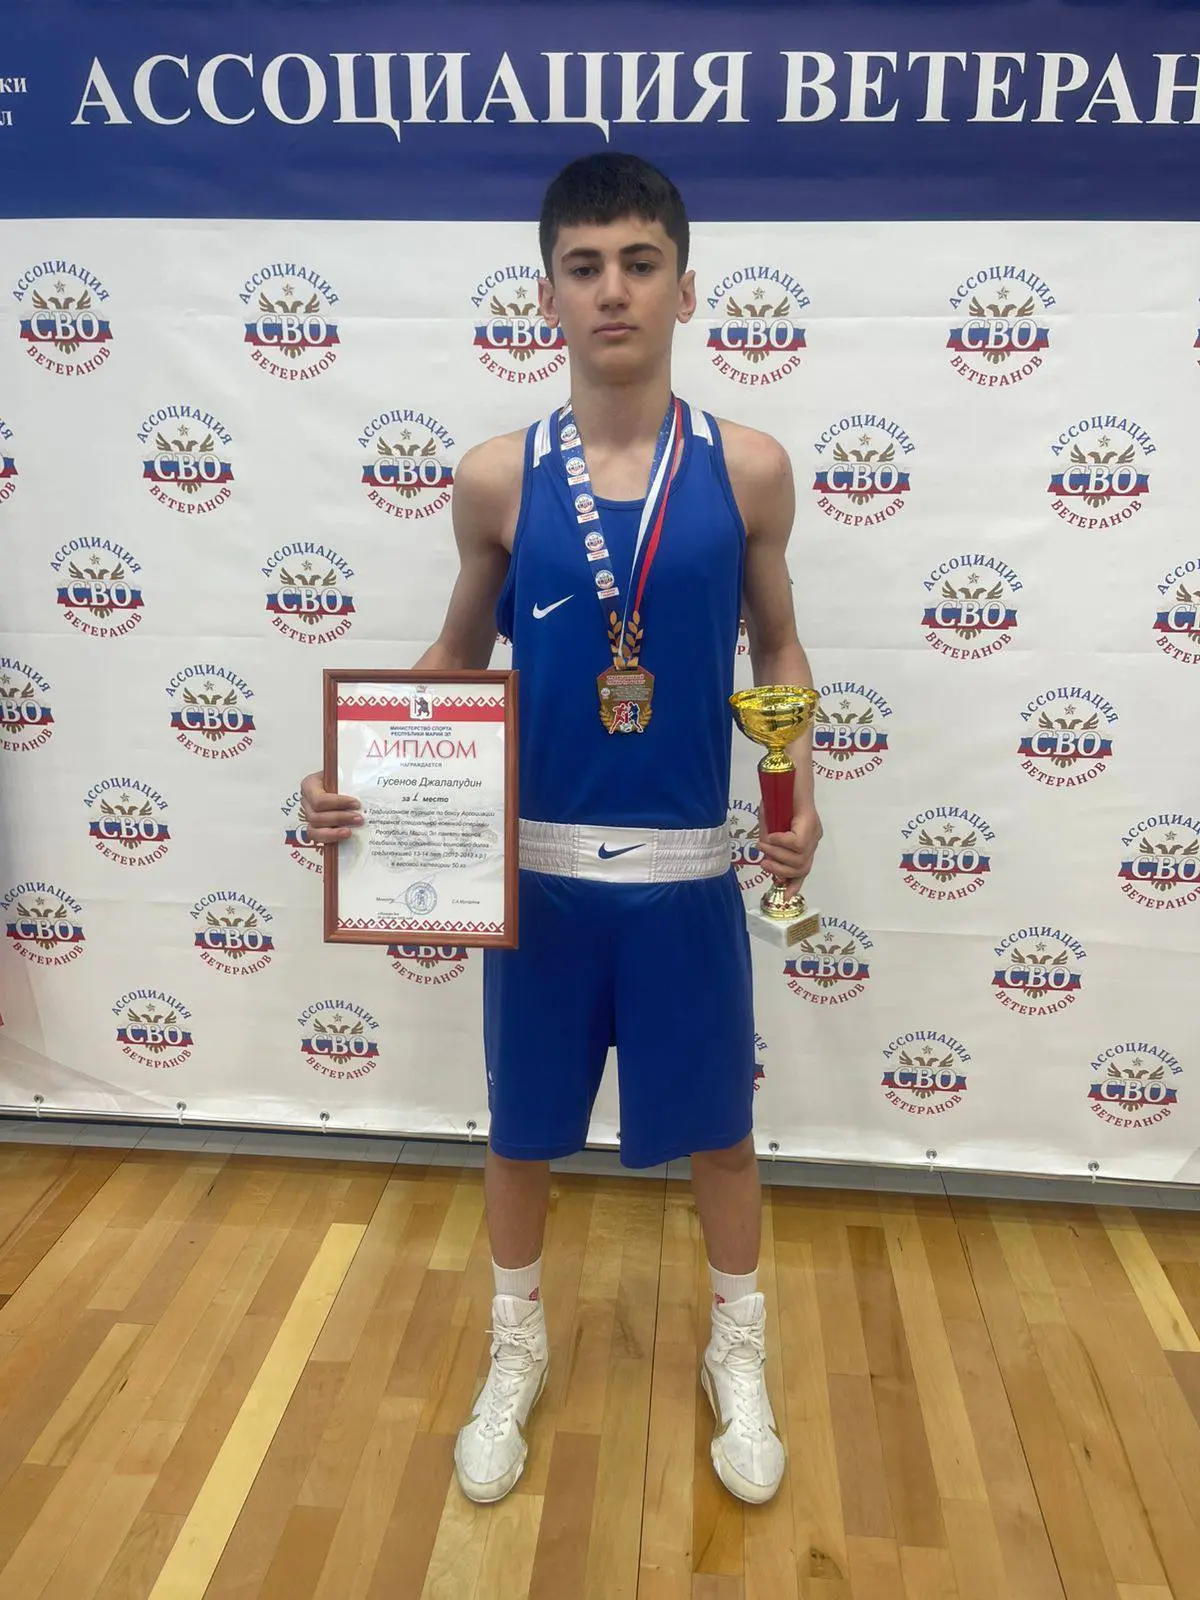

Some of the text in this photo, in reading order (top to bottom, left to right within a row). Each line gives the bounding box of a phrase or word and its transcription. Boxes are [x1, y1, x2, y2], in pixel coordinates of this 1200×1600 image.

[70, 51, 1200, 143] АССОЦИАЦИЯ ВЕТЕРАН
[12, 260, 109, 302] АССОЦИАЦИЯ
[239, 263, 339, 306] АССОЦИАЦИЯ
[470, 266, 541, 307] АССОЦИА
[707, 266, 811, 308] АССОЦИАЦИЯ
[949, 266, 1056, 309] АССОЦИАЦИЯ
[29, 312, 100, 341] СВО
[255, 315, 327, 345] СВО
[486, 317, 558, 348] СВО
[720, 319, 794, 349] СВО
[960, 318, 1037, 349] СВО
[26, 344, 112, 376] ВЕТЕРАНОВ
[250, 349, 338, 381] ВЕТЕРАНОВ
[478, 352, 567, 384] ВЕТЕРАНОВ
[711, 354, 802, 386] ВЕТЕРАНОВ
[949, 354, 1044, 387] ВЕТЕРАНОВ
[137, 406, 232, 444] АССОЦИАЦИЯ
[358, 410, 455, 448] АССОЦИАЦИЯ
[814, 415, 915, 454] АССОЦИАЦИЯ
[1051, 416, 1156, 457] АССОЦИАЦИЯ
[154, 453, 221, 482] СВО
[373, 457, 443, 485] СВО
[826, 464, 898, 493] СВО
[1062, 466, 1137, 495] СВО
[150, 487, 232, 514] ВЕТЕРАНОВ
[368, 489, 451, 519] ВЕТЕРАНОВ
[817, 497, 905, 526] ВЕТЕРАНОВ
[1052, 499, 1142, 529] ВЕТЕРАНОВ
[51, 537, 141, 574] АССОЦИАЦИЯ
[261, 543, 354, 579] АССОЦИАЦИЯ
[923, 555, 1023, 592] АССОЦИАЦИЯ
[67, 580, 132, 608] СВО
[277, 586, 343, 614] СВО
[64, 610, 141, 637] ВЕТЕРАНОВ
[935, 601, 1006, 629] СВО
[272, 617, 352, 644] ВЕТЕРАНОВ
[925, 632, 1011, 659] ВЕТЕРАНОВ
[166, 664, 255, 700] АССОЦИАЦИЯ
[821, 682, 893, 718] ОЦИАЦИЯ
[1020, 687, 1118, 725] АССОЦИАЦИЯ
[181, 706, 243, 731] СВО
[177, 734, 253, 759] ВЕТЕРАНОВ
[366, 739, 477, 759] ДИПЛОМ
[813, 725, 877, 751] СВО
[1031, 729, 1101, 757] СВО
[812, 756, 883, 780] ТЕРАНОВ
[1021, 760, 1106, 787] ВЕТЕРАНОВ
[85, 778, 168, 810] АССОЦИАЦИЯ
[377, 777, 482, 789] Гусенов Джалалудин
[98, 816, 158, 840] СВО
[901, 808, 995, 841] АССОЦИАЦИЯ
[96, 842, 169, 866] ВЕТЕРАНОВ
[912, 846, 979, 872] СВО
[1131, 855, 1200, 881] СВО
[0, 881, 82, 914] АССОЦИАЦИЯ
[904, 874, 985, 901] ВЕТЕРАНОВ
[190, 891, 272, 924] АССОЦИАЦИЯ
[14, 918, 74, 941] СВО
[204, 927, 262, 951] СВО
[994, 927, 1086, 960] АССОЦИАЦИЯ
[12, 942, 84, 965] ВЕТЕРАНОВ
[200, 951, 271, 975] ВЕТЕРАНОВ
[795, 953, 859, 978] СВО
[392, 961, 465, 985] ВЕТЕРАНОВ
[1004, 964, 1070, 990] СВО
[112, 990, 192, 1021] АССОЦИАЦИЯ
[787, 980, 864, 1005] ВЕТЕРАНОВ
[995, 990, 1075, 1016] ВЕТЕРАНОВ
[297, 1000, 379, 1031] АССОЦИАЦИЯ
[126, 1023, 182, 1046] СВО
[310, 1032, 369, 1056] СВО
[882, 1031, 971, 1064] АССОЦИАЦИЯ
[123, 1046, 191, 1069] ВЕТЕРАНОВ
[306, 1056, 377, 1080] ВЕТЕРАНОВ
[1091, 1043, 1183, 1076] АССОЦИАЦИЯ
[893, 1065, 956, 1090] СВО
[1100, 1078, 1166, 1103] СВО
[885, 1090, 962, 1115] ВЕТЕРАНОВ
[1091, 1103, 1172, 1128] ВЕТЕРАНОВ
